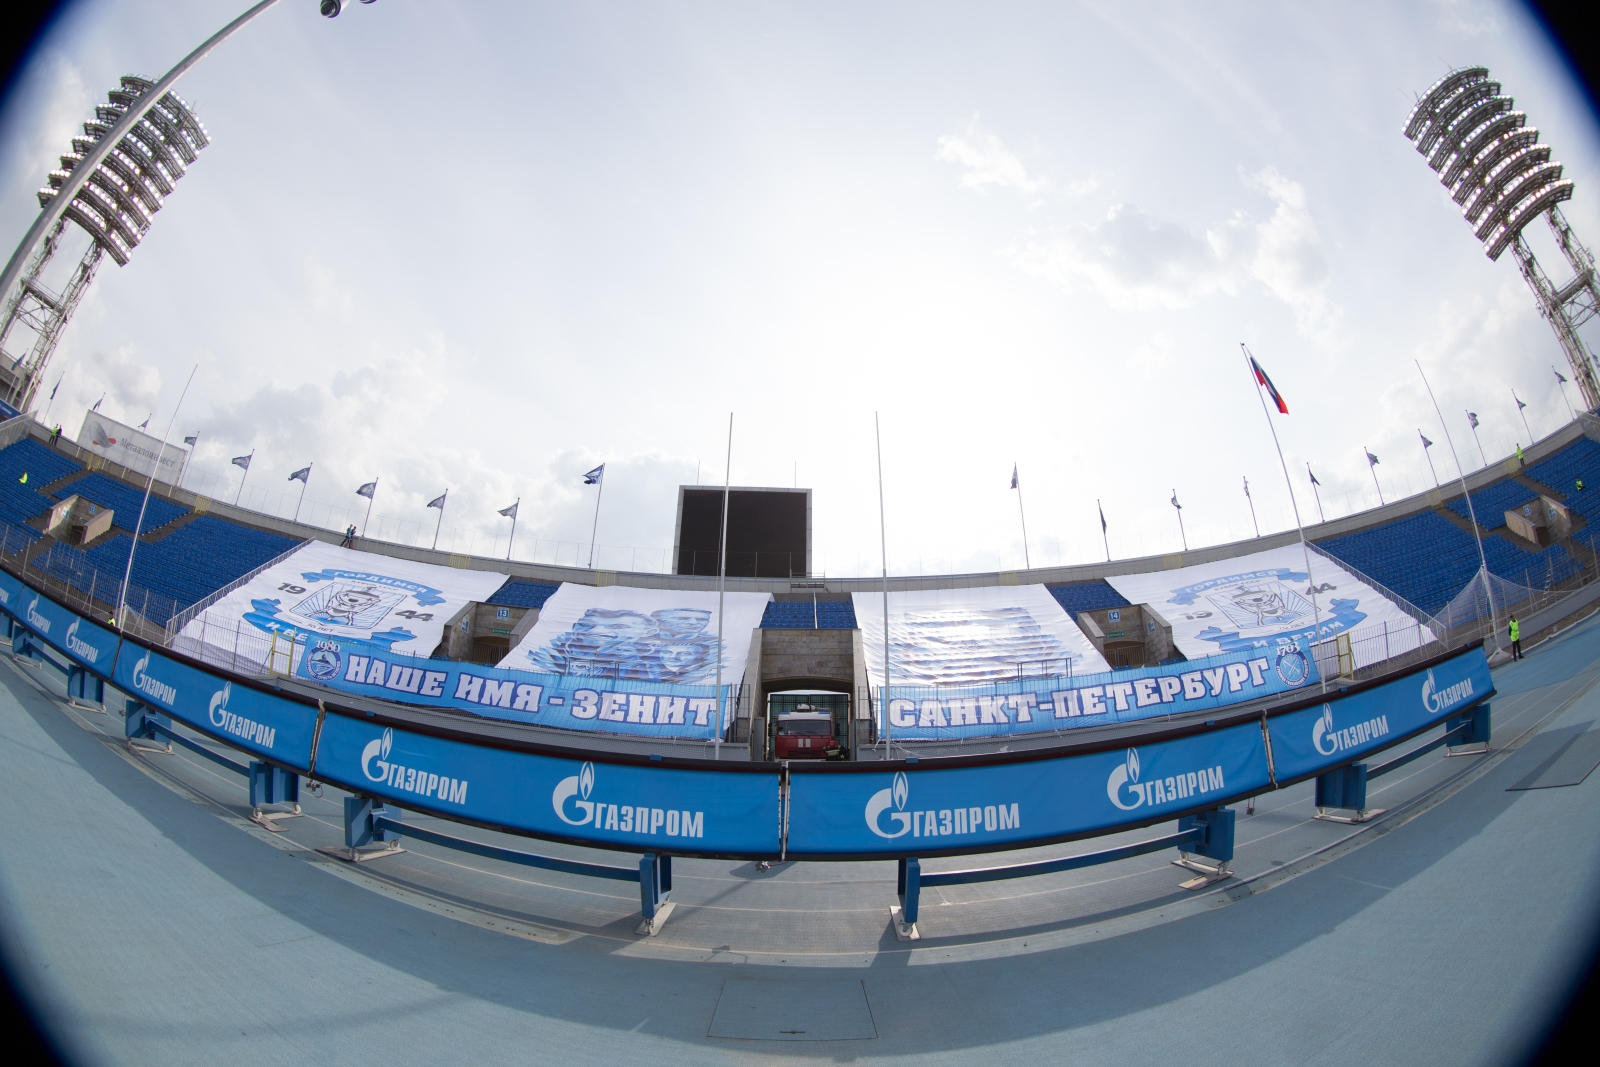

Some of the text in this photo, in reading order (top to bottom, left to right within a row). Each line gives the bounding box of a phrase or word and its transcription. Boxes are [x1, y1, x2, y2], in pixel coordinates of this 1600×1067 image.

[278, 583, 306, 594] 19
[334, 572, 427, 593] ГОРДИМСЯ
[1185, 571, 1278, 593] ГОРДИМСЯ
[1306, 582, 1337, 595] 44
[395, 610, 434, 622] 44
[1179, 610, 1212, 620] 19
[72, 636, 98, 663] ГАЗПРОМ
[317, 640, 340, 652] 1980
[1276, 642, 1300, 656] 1703
[142, 674, 176, 705] ГАЗПРОМ
[346, 653, 448, 696] НАШЕ
[454, 672, 543, 712] ИМЯ
[571, 689, 717, 726] ЗЕНИТ
[889, 657, 1269, 727] САНКТ-ПЕТЕРБУРГ
[1437, 678, 1473, 709] ГАЗПРОМ
[223, 713, 276, 749] ГАЗПРОМ
[1337, 715, 1389, 751] ГАЗПРОМ
[387, 764, 468, 805] ГАЗПРОМ
[1145, 765, 1225, 806] ГАЗПРОМ
[595, 802, 703, 838] ГАЗПРОМ
[913, 803, 1020, 838] ГАЗПРОМ
